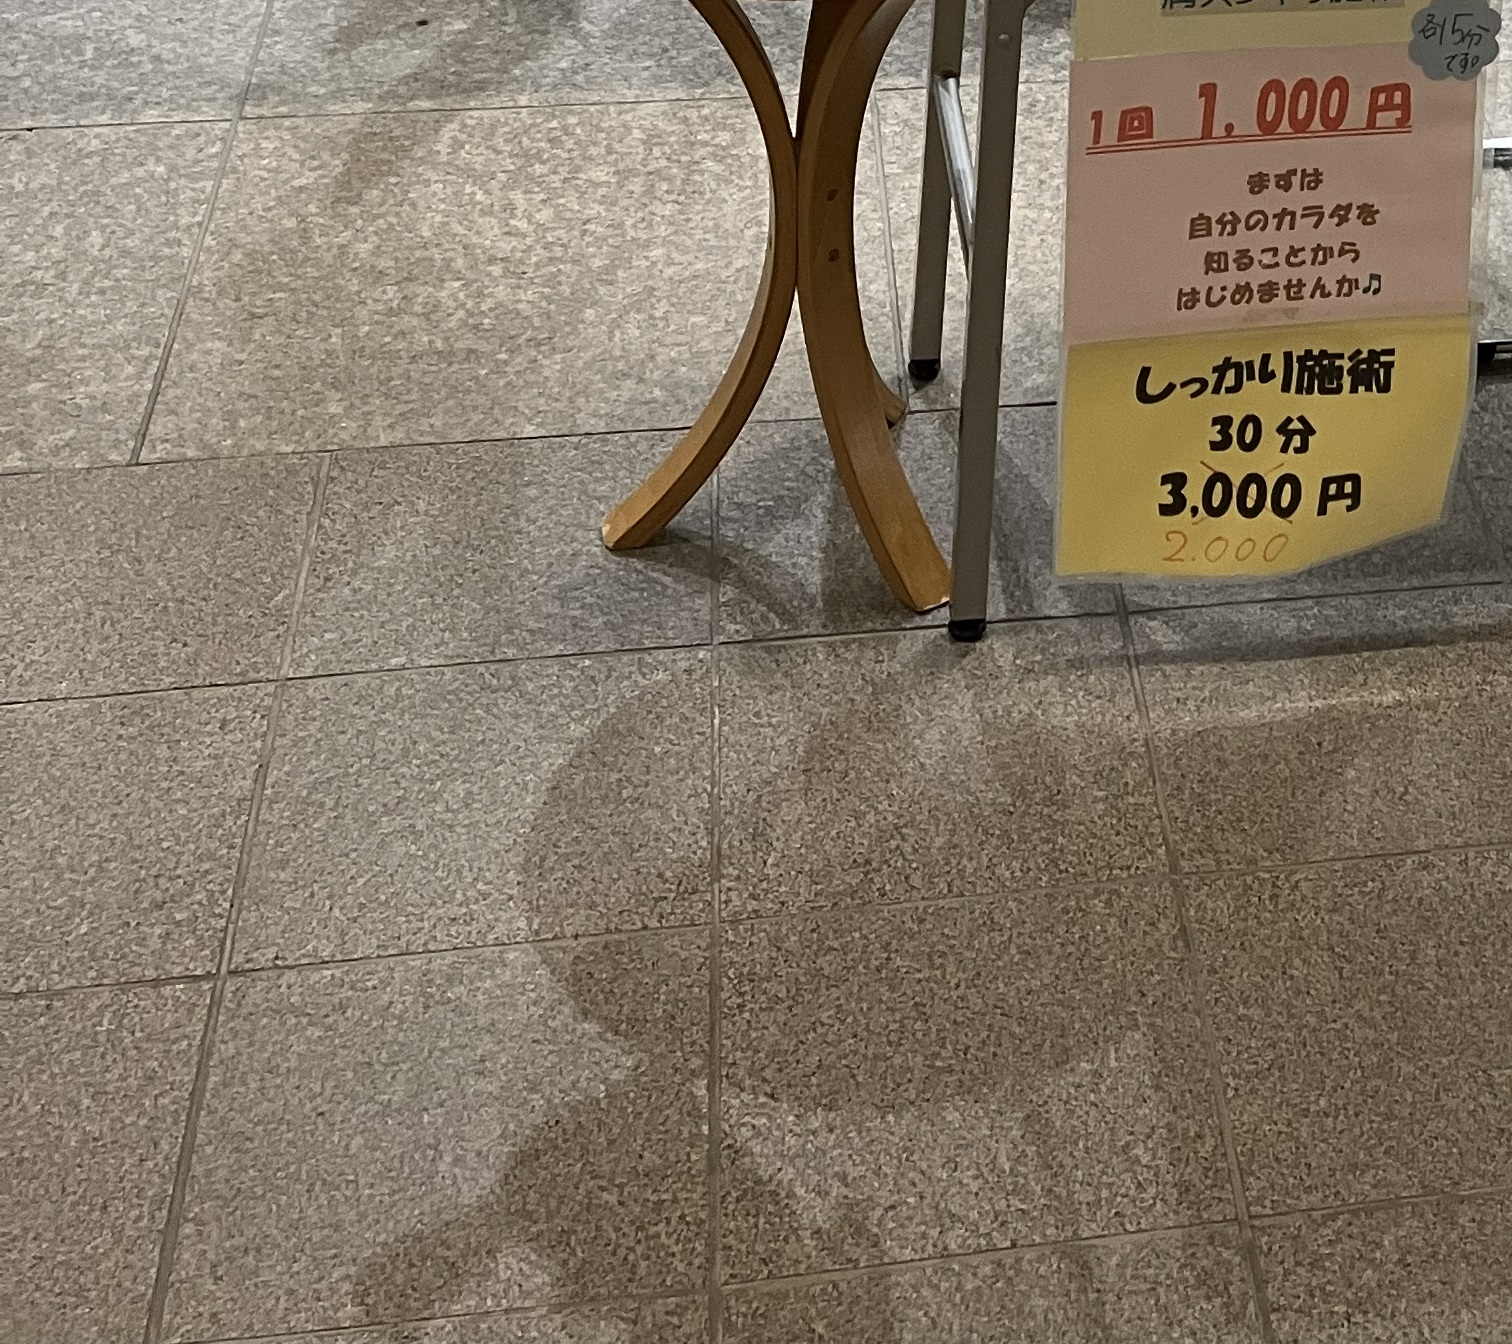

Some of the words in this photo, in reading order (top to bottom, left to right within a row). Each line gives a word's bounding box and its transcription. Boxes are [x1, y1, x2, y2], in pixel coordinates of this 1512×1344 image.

[1090, 105, 1154, 144] 1回
[1247, 168, 1324, 195] まずは
[1188, 202, 1381, 240] 自分のカラダを
[1203, 242, 1361, 275] 知ることから
[1135, 347, 1396, 404] しっかり施術
